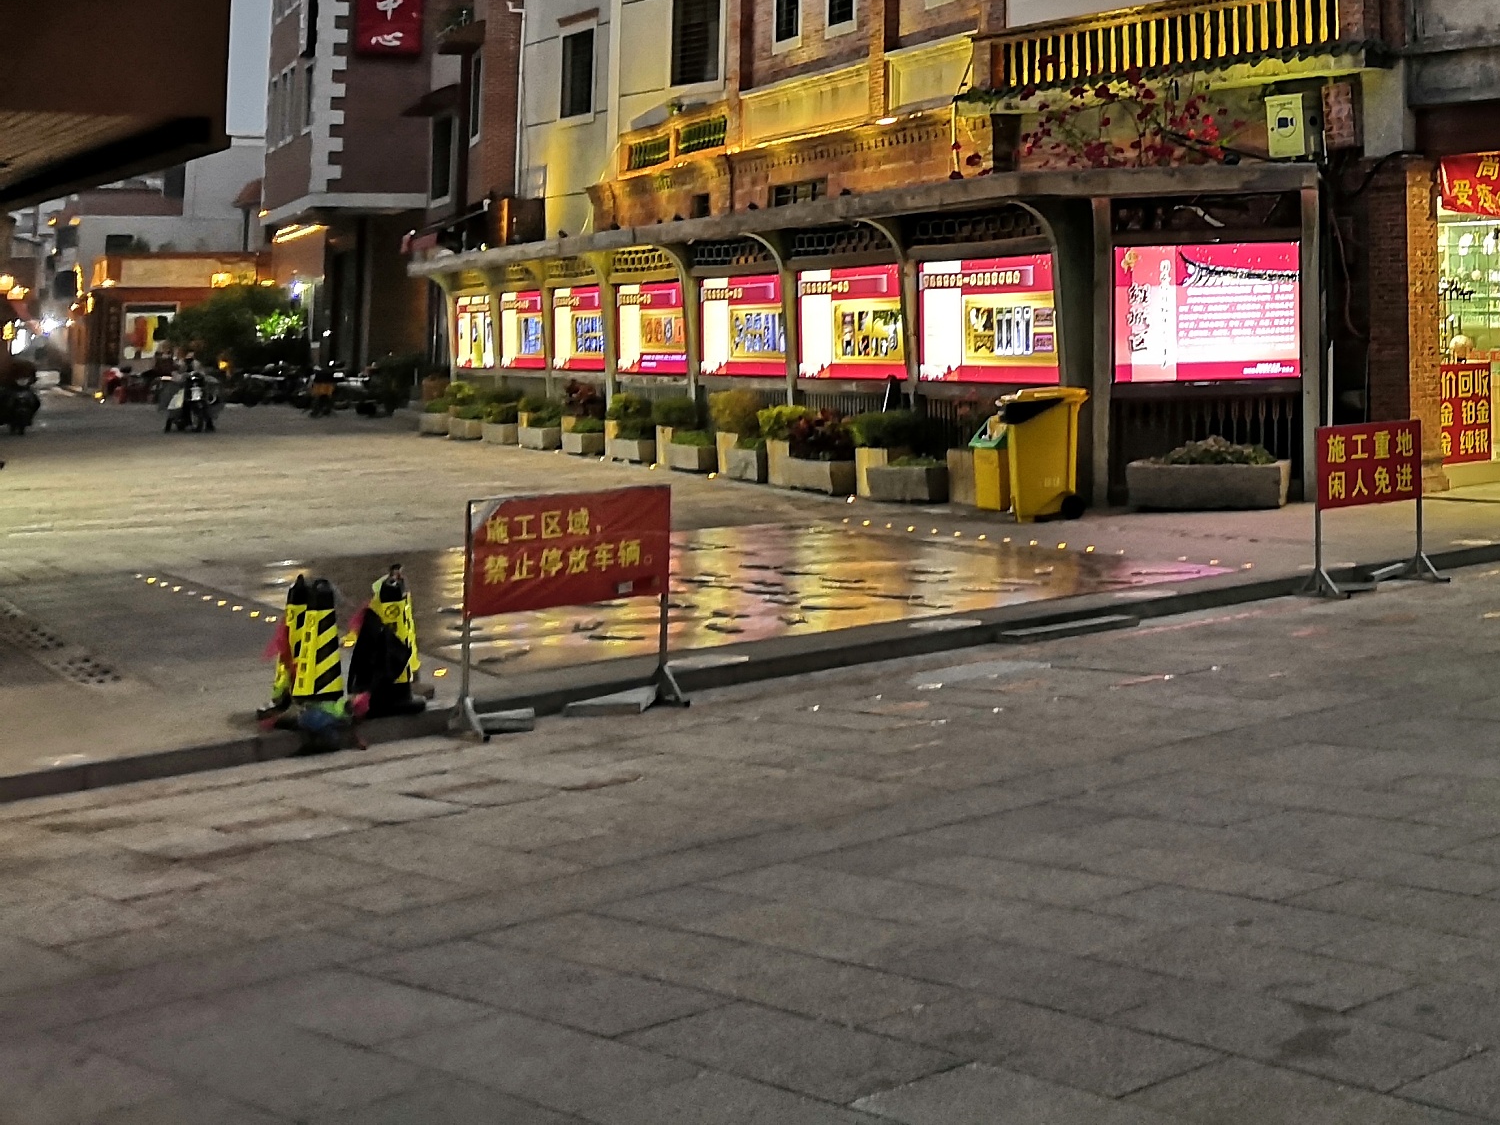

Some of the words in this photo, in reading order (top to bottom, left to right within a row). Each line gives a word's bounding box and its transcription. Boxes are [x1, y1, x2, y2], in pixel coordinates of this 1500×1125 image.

[1327, 428, 1414, 464] 施工重地
[1328, 463, 1414, 500] 闲人免进
